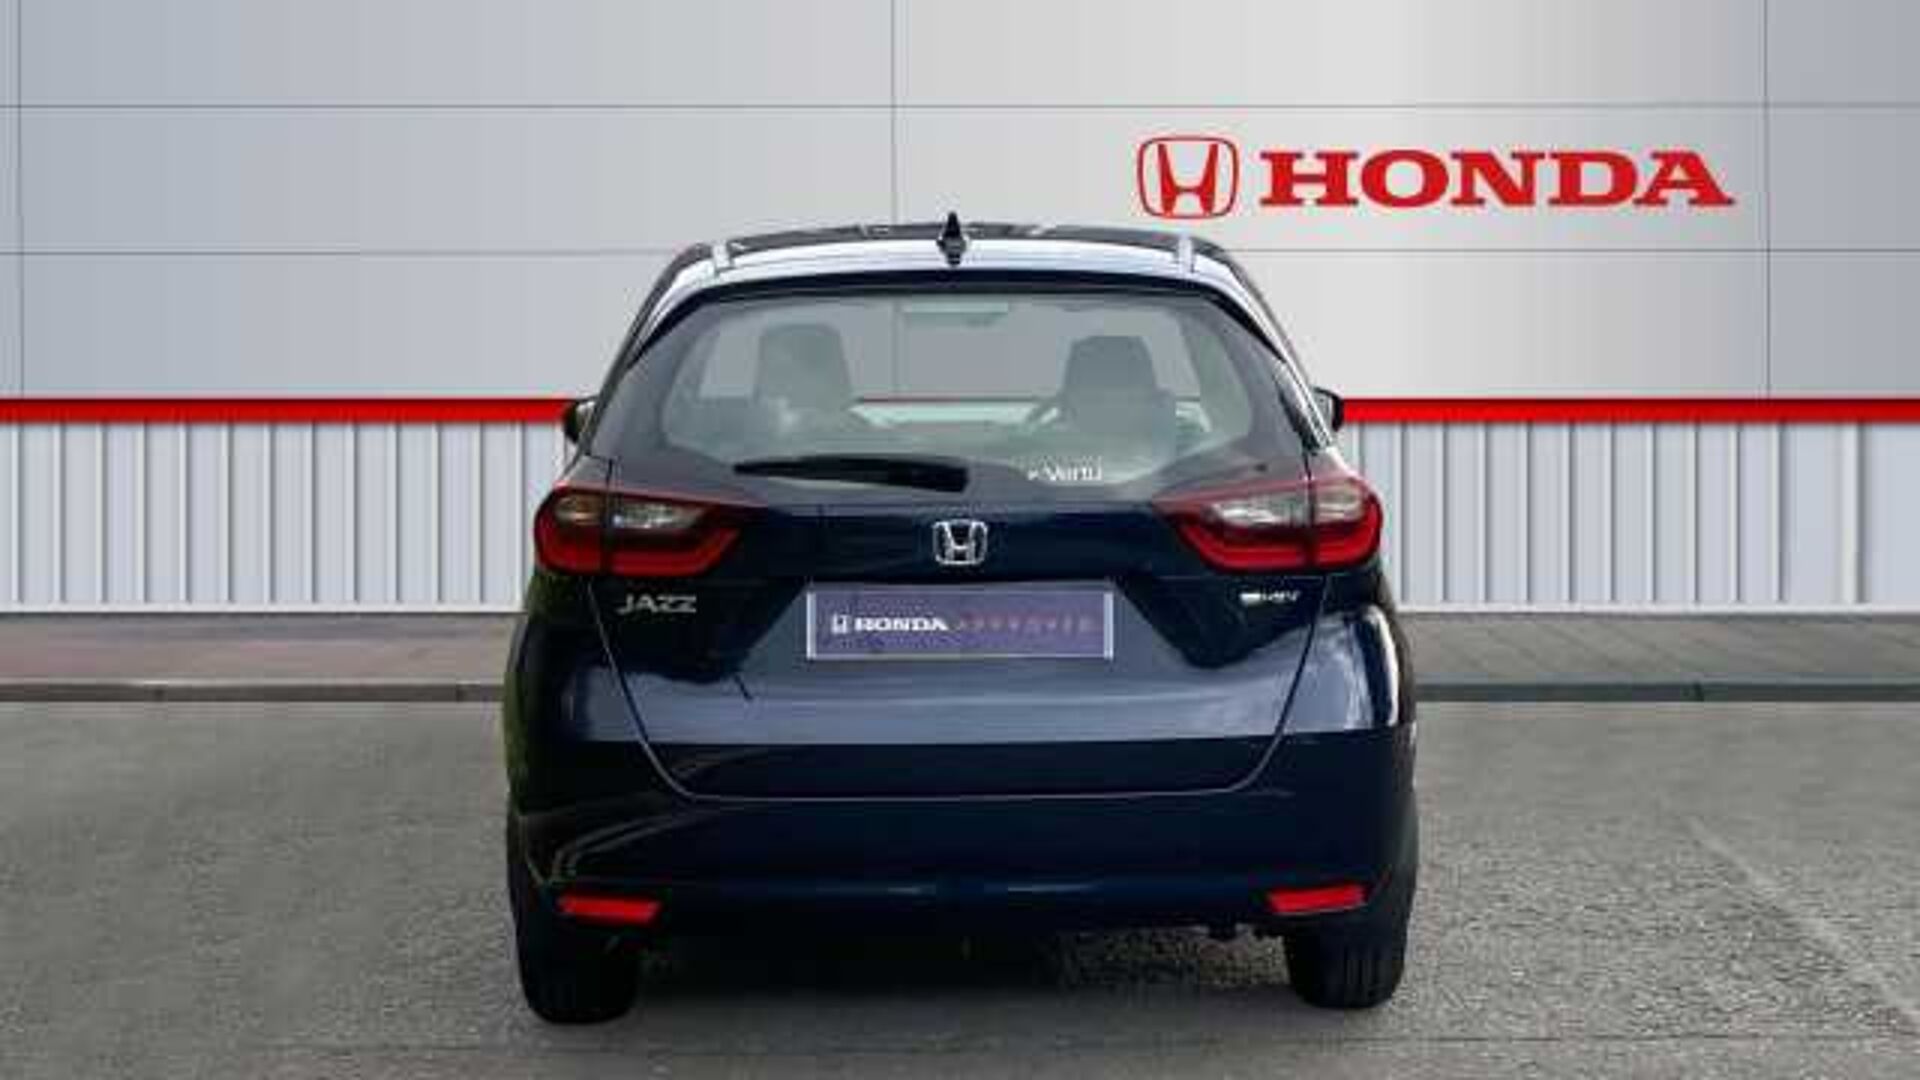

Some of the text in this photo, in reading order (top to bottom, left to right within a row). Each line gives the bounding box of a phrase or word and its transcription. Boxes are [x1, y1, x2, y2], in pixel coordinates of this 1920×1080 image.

[1260, 150, 1735, 207] HONDA
[616, 594, 697, 614] JAZZ
[854, 617, 949, 632] HONDA
